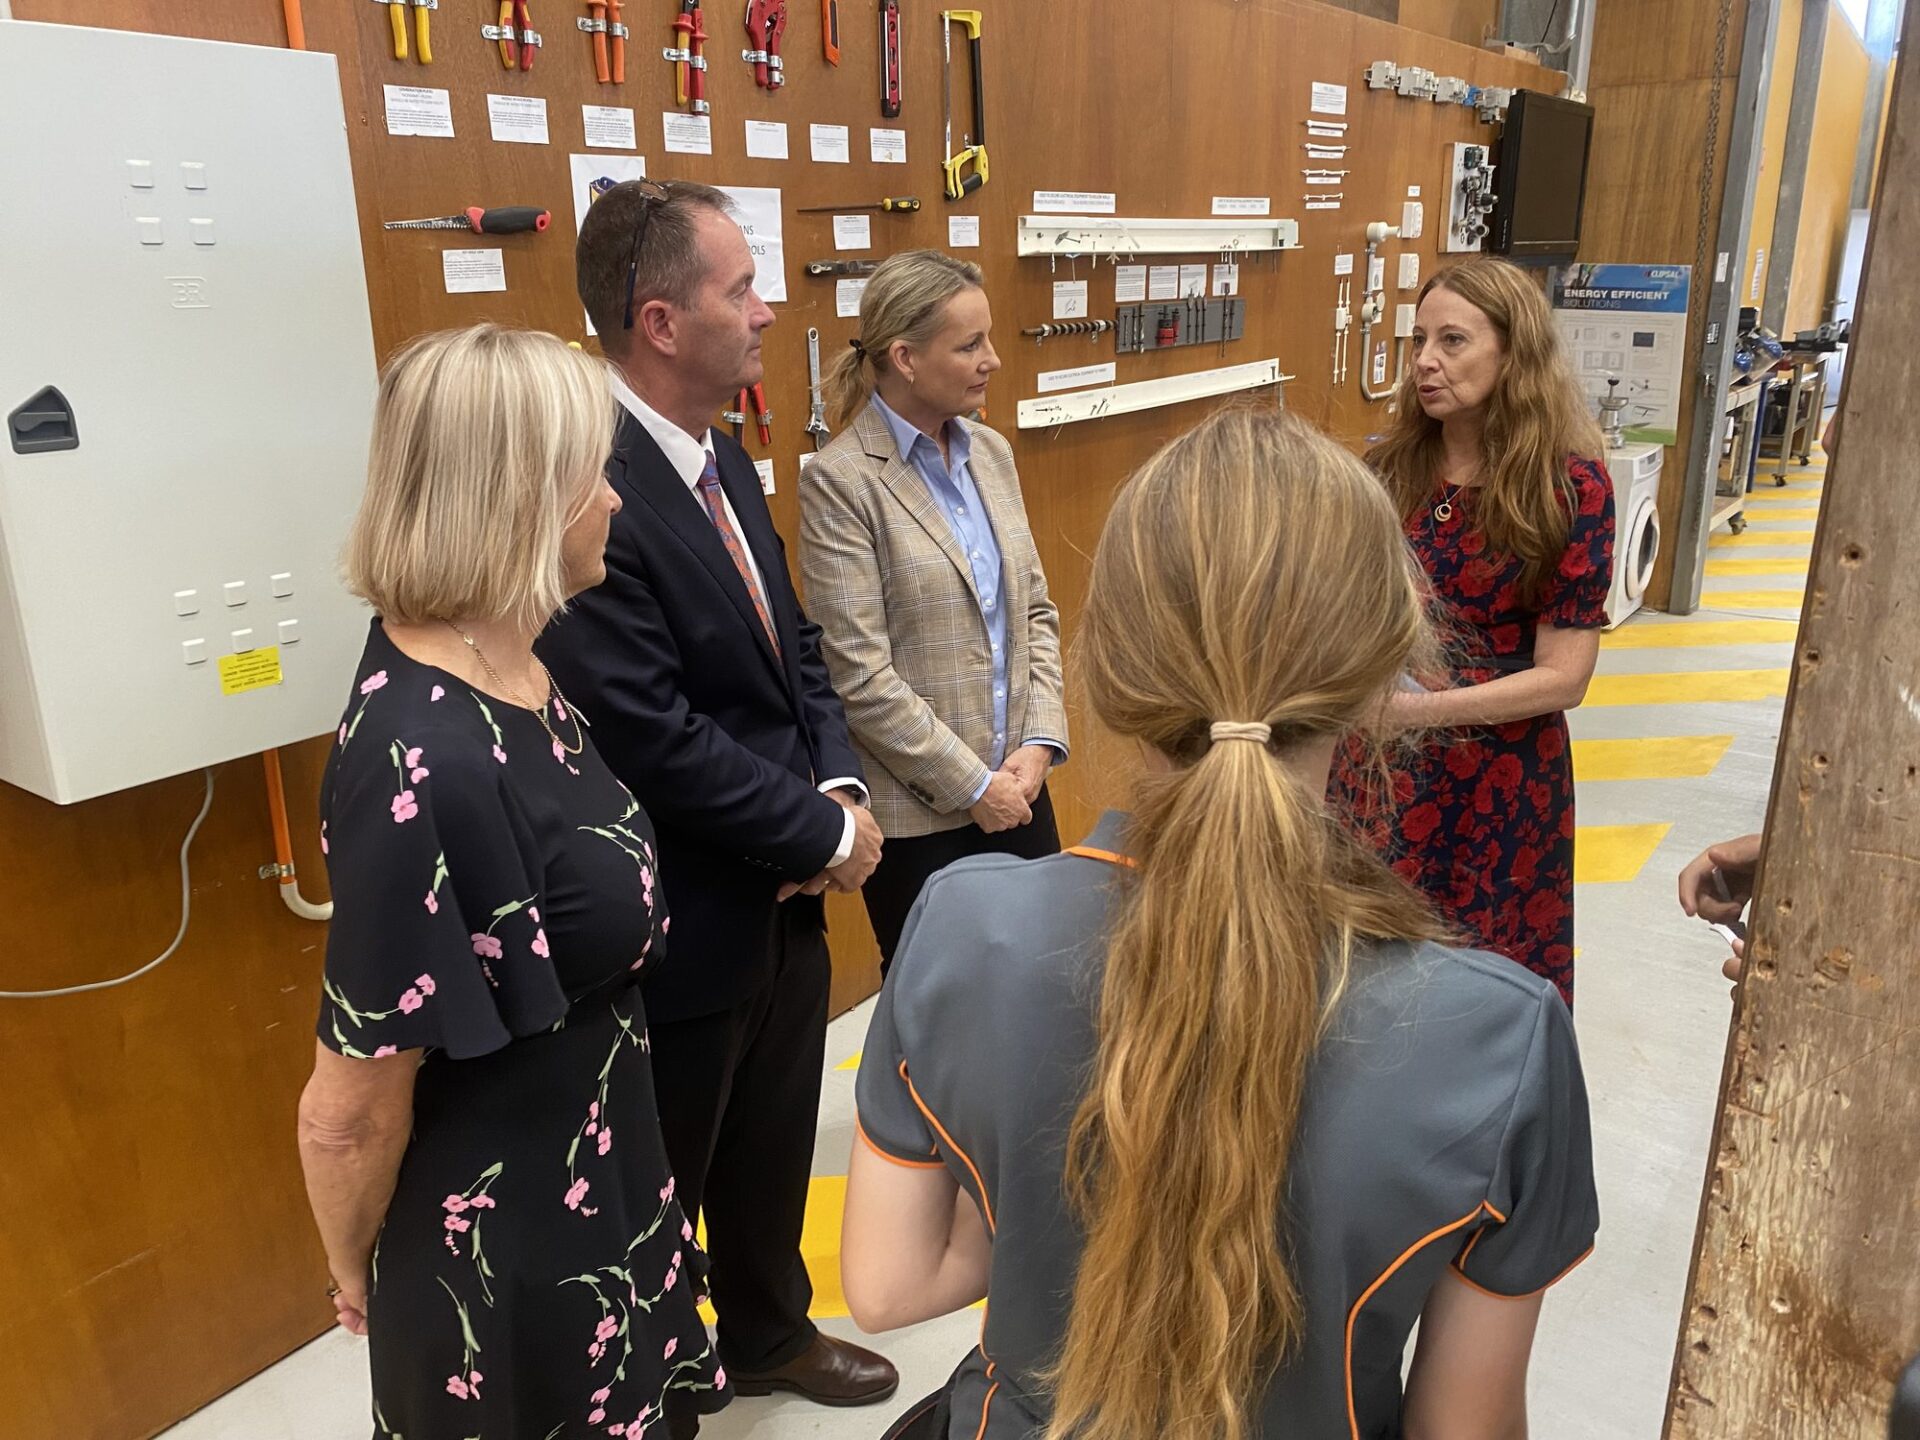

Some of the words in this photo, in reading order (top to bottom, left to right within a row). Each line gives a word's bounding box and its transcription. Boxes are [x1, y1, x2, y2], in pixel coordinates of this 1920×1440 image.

[1563, 289, 1608, 299] ENERGY
[1611, 290, 1670, 300] EFFICIENT
[1562, 299, 1621, 309] SOLUTIONS
